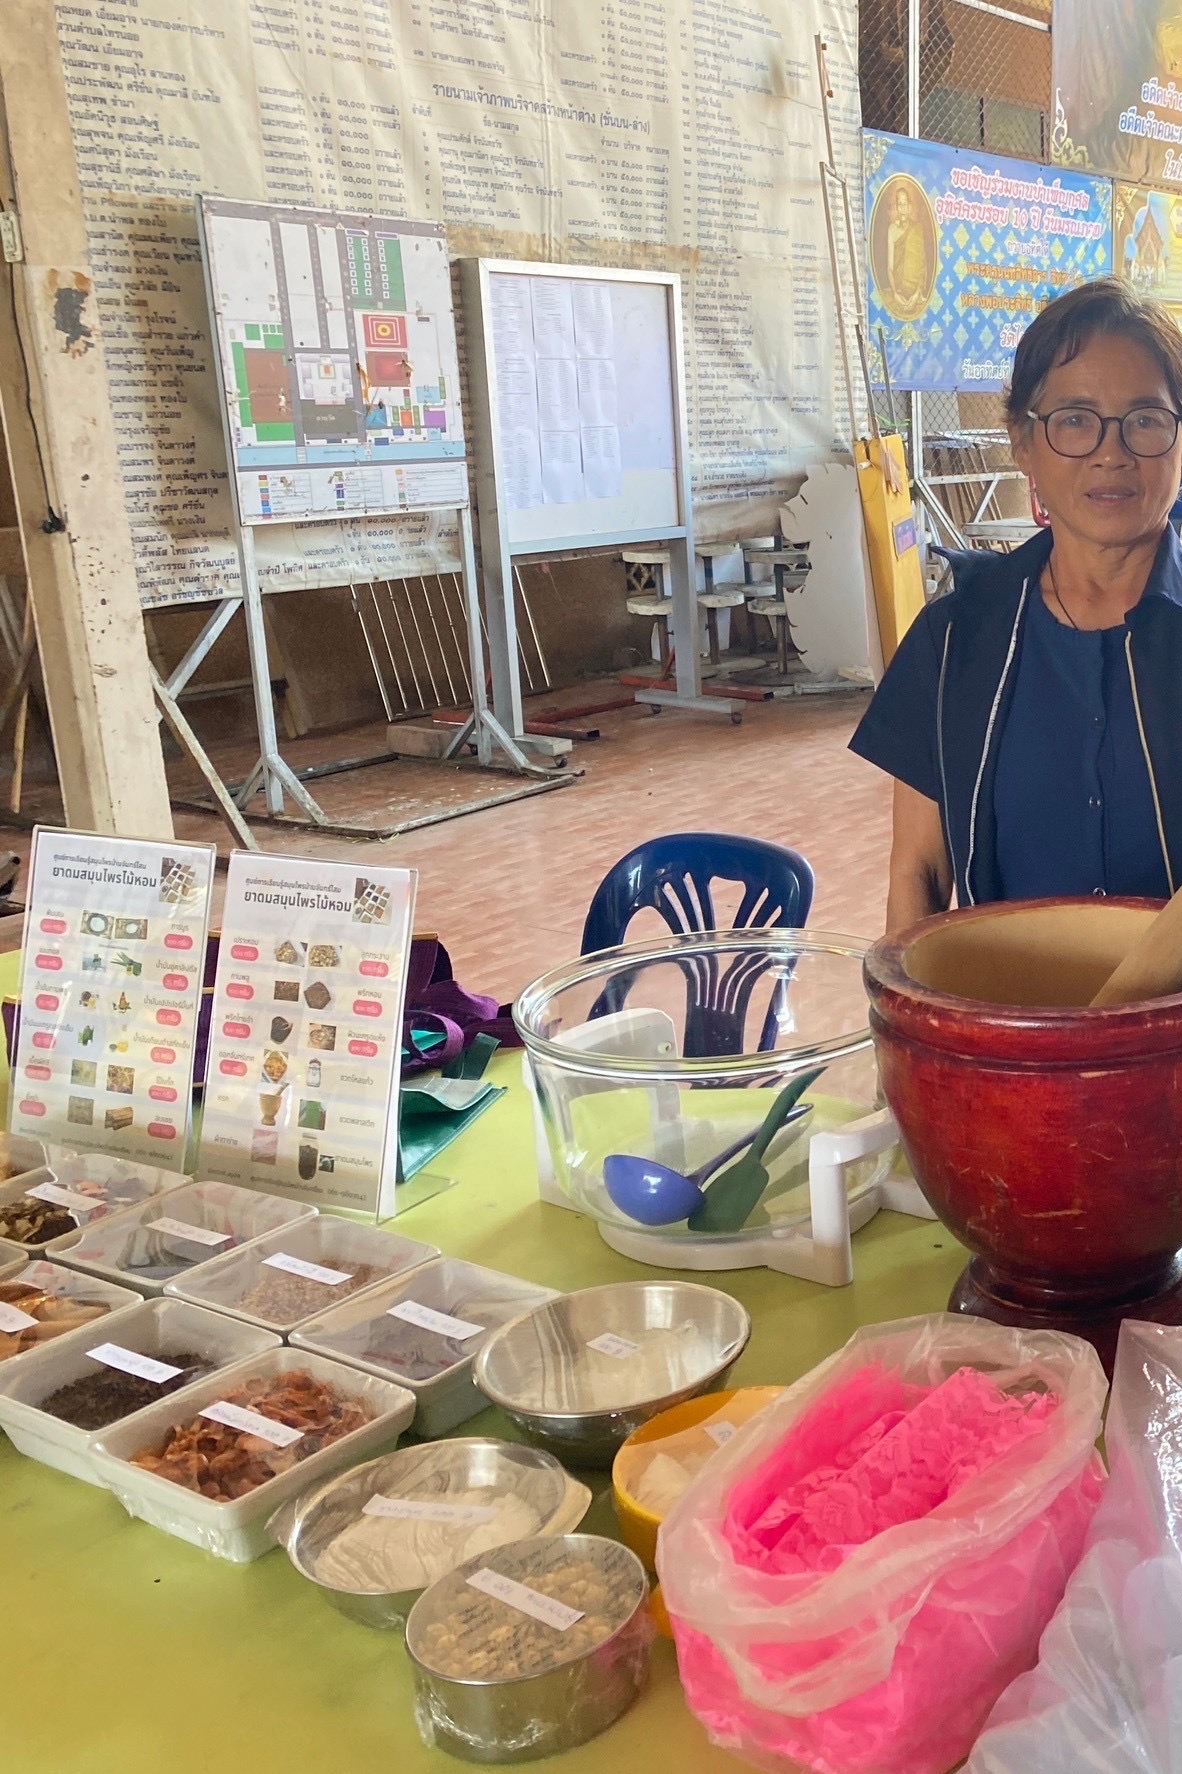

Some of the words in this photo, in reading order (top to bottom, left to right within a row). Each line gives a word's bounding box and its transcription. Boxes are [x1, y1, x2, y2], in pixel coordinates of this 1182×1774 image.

[53, 866, 156, 887] ยาดมสมุนไพรไม้หอม
[244, 891, 351, 912] ยาดมสมุนไพรไม้หอม
